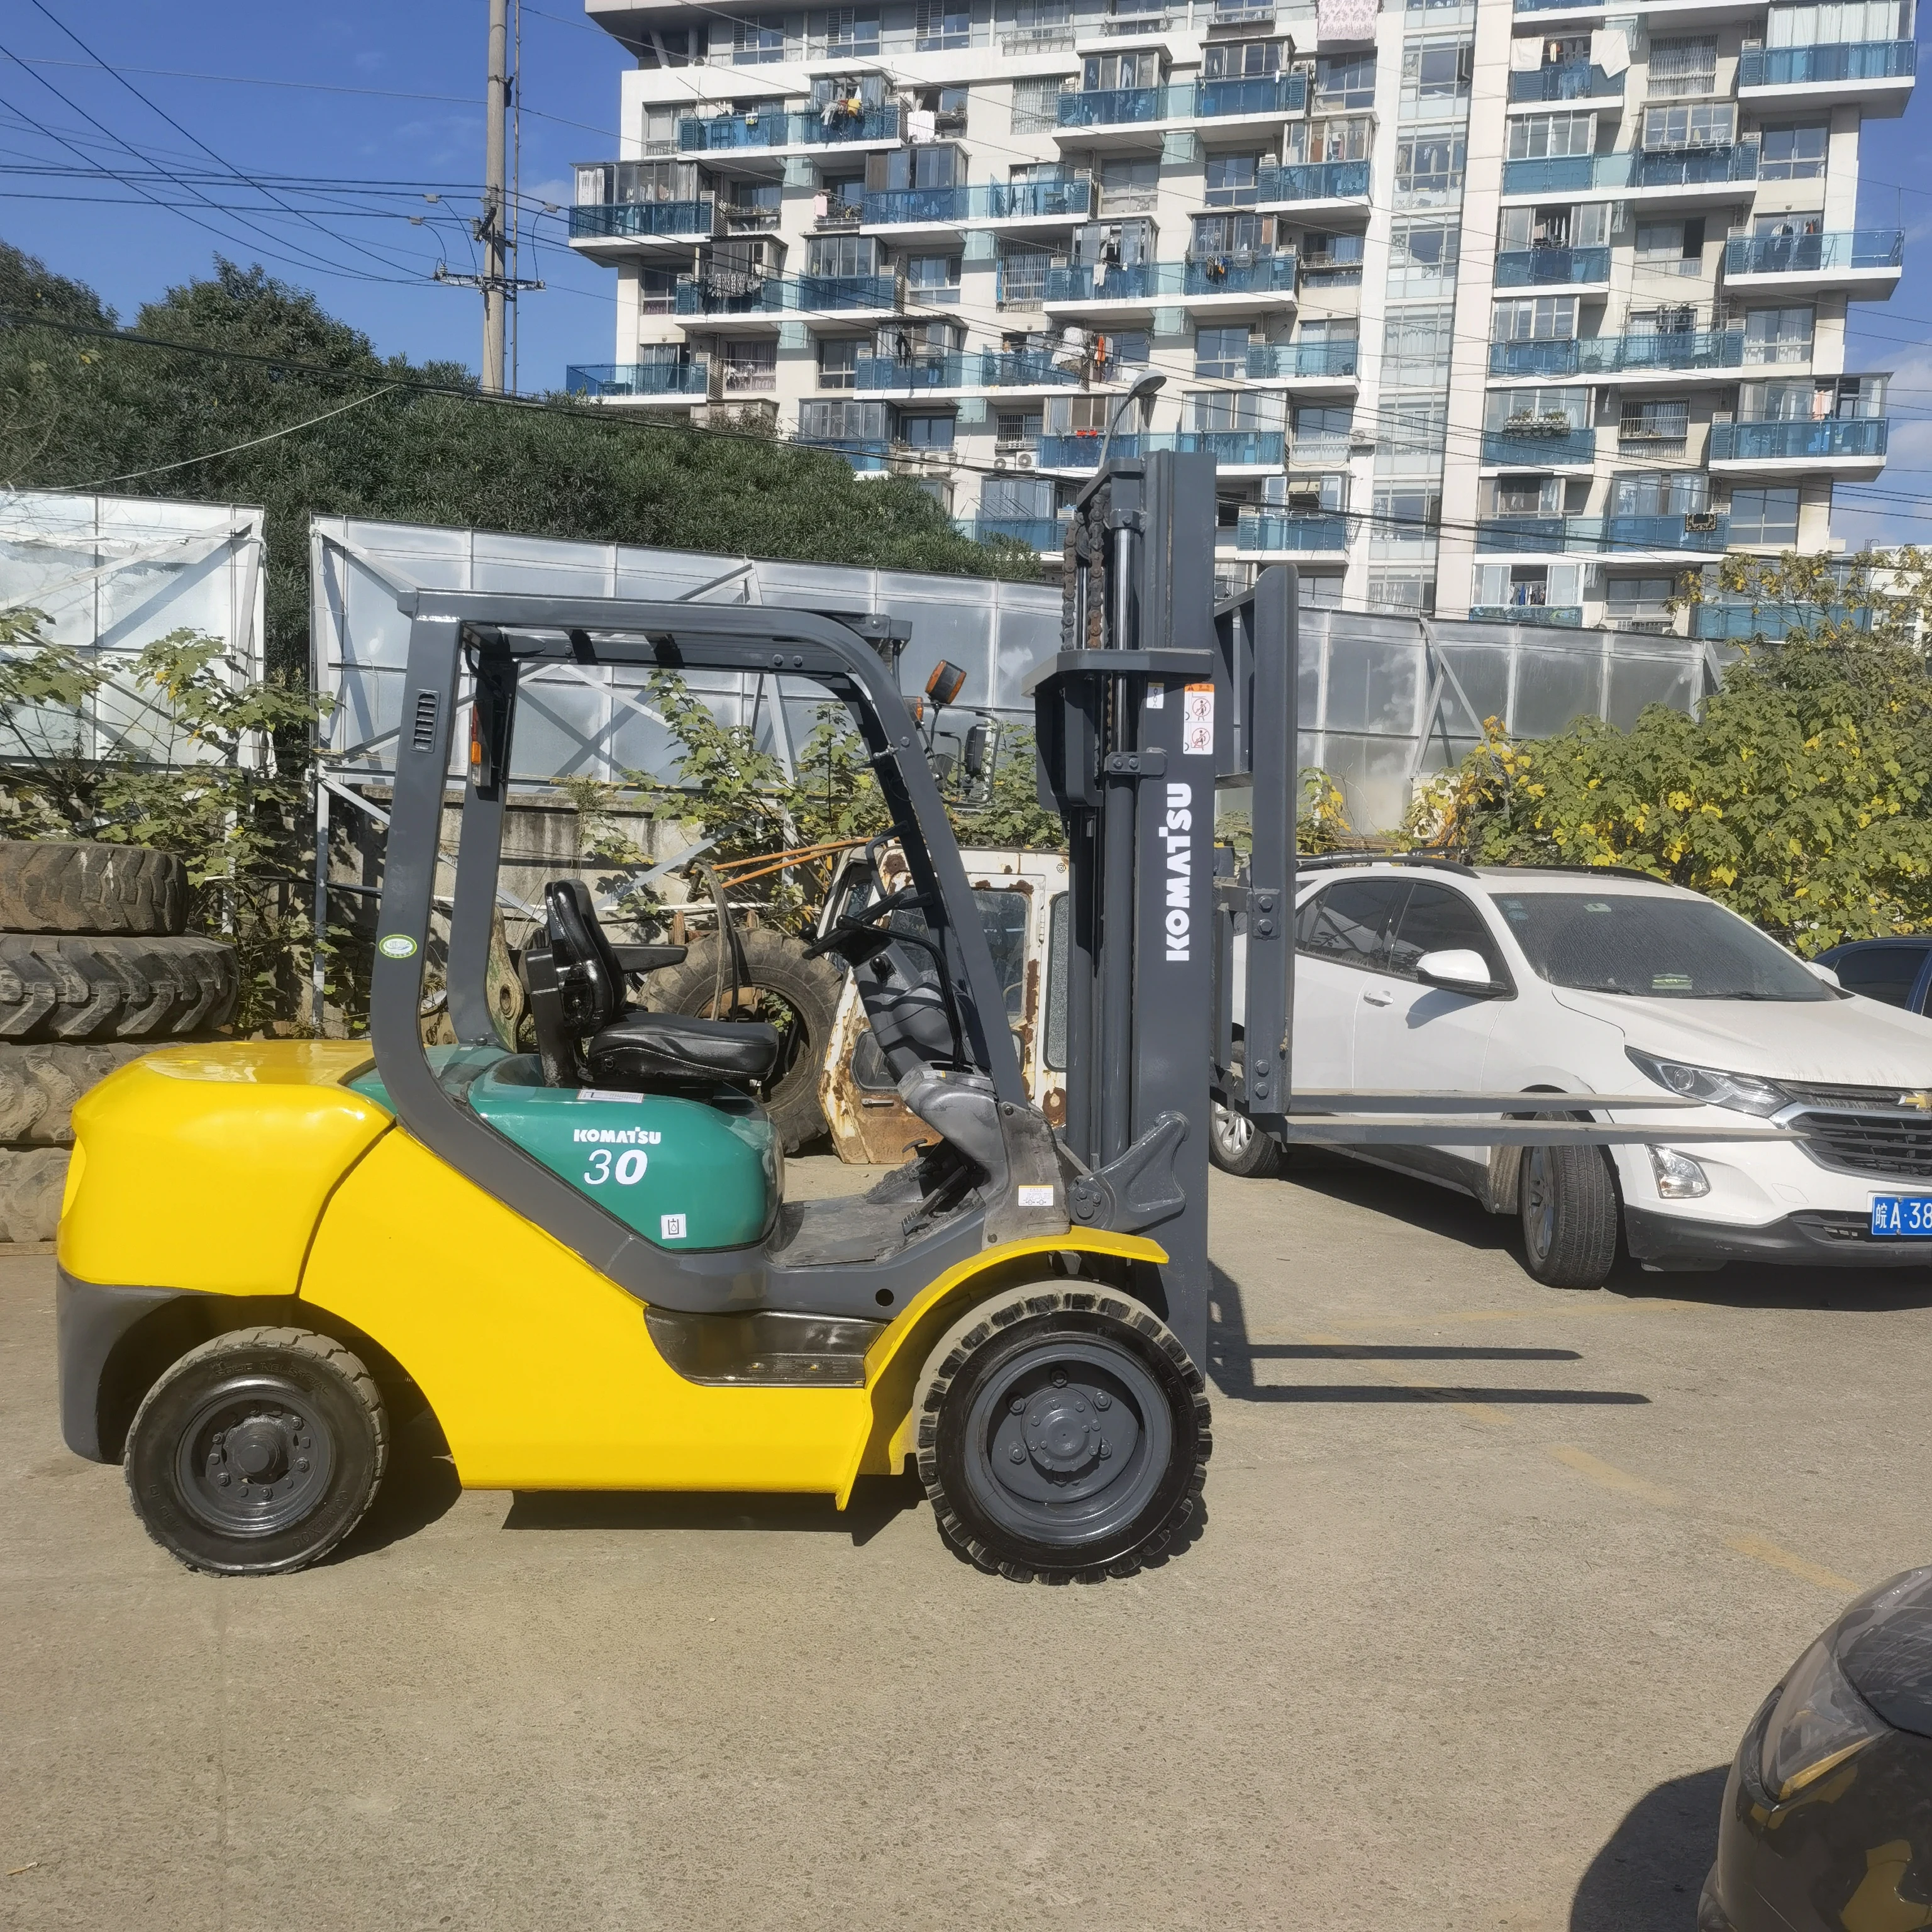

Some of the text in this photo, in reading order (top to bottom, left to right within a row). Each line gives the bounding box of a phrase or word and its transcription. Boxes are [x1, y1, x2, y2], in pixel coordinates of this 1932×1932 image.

[1158, 783, 1192, 961] KOMATSU
[574, 1126, 662, 1145] KOMATSU
[584, 1148, 648, 1185] 30
